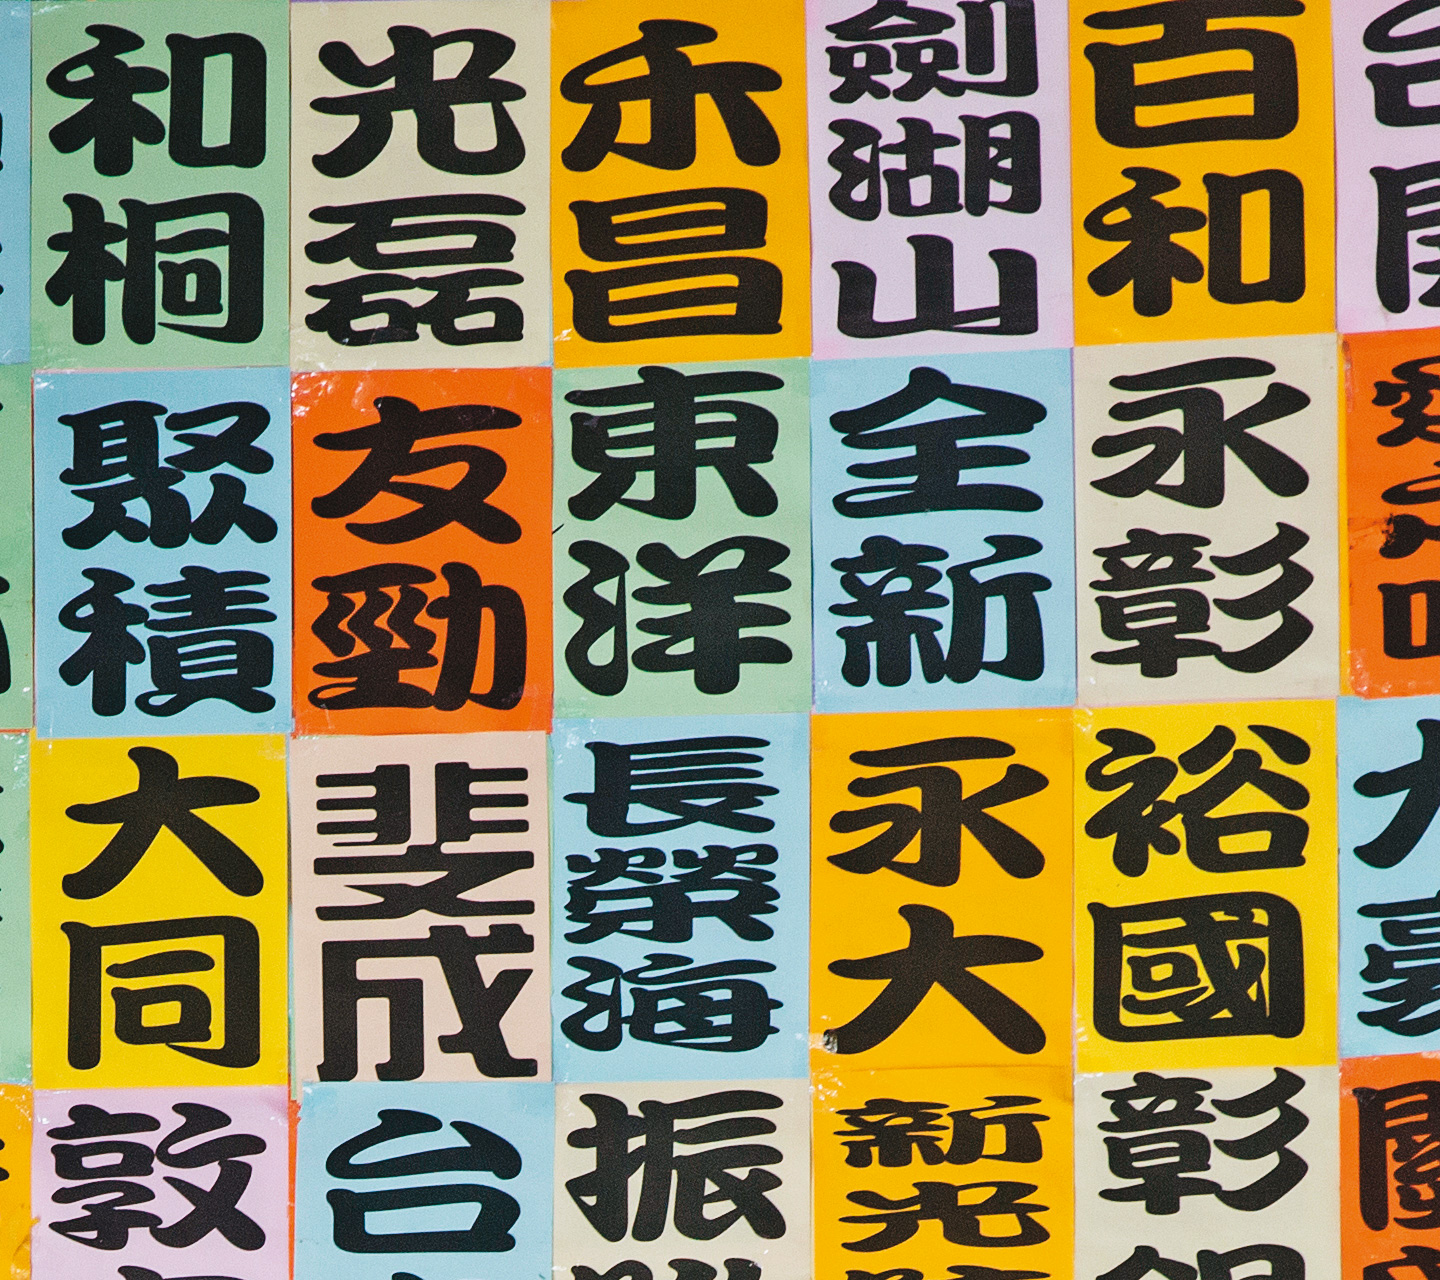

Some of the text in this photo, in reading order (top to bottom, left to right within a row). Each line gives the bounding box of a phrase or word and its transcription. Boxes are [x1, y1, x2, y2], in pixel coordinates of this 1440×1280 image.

[45, 24, 266, 345] 和桐
[305, 26, 526, 346] 光磊
[826, 0, 1041, 338] 劍湖山
[1084, 0, 1305, 316] 百和
[58, 401, 277, 716] 聚積
[308, 397, 526, 711] 友勁
[563, 366, 792, 696] 東洋
[829, 367, 1051, 686] 全新
[1090, 357, 1313, 678] 永彰
[61, 747, 263, 1069] 大同
[314, 762, 537, 1079] 斐成
[561, 737, 783, 1052] 長榮海
[825, 737, 1048, 1054] 永大
[1085, 725, 1310, 1042] 裕國
